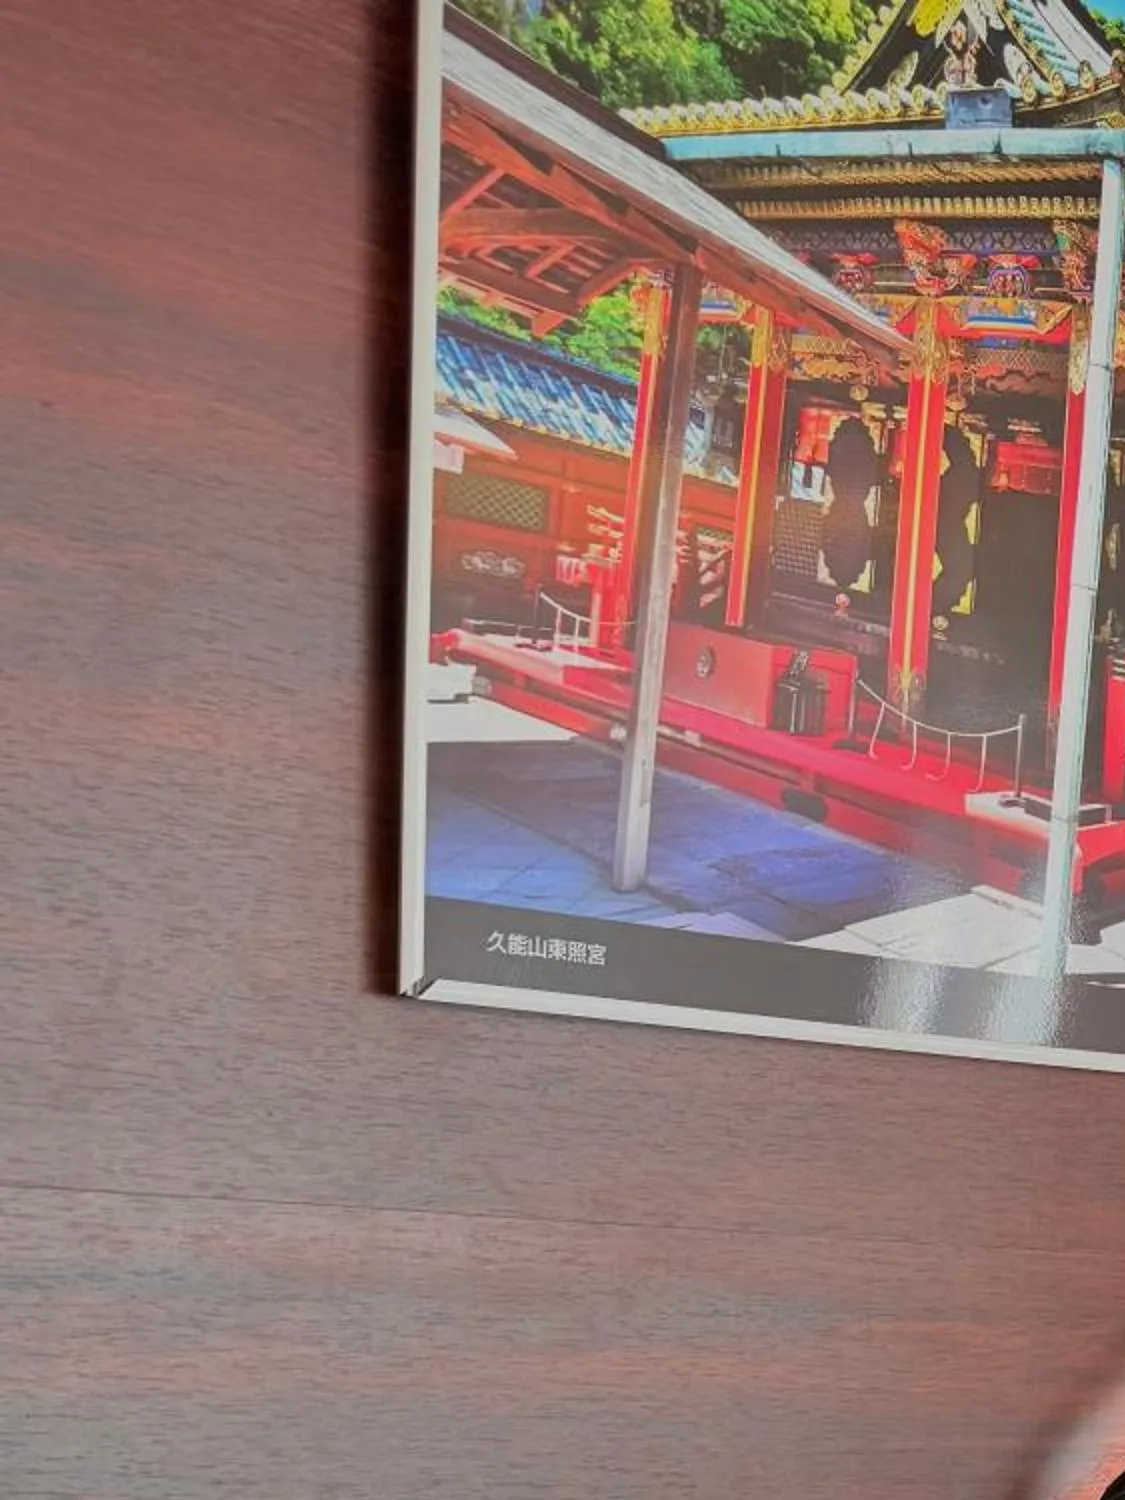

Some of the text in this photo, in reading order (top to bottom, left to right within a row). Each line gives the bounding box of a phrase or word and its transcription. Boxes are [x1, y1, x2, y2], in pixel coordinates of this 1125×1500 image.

[486, 930, 607, 966] 久能山東照宮
